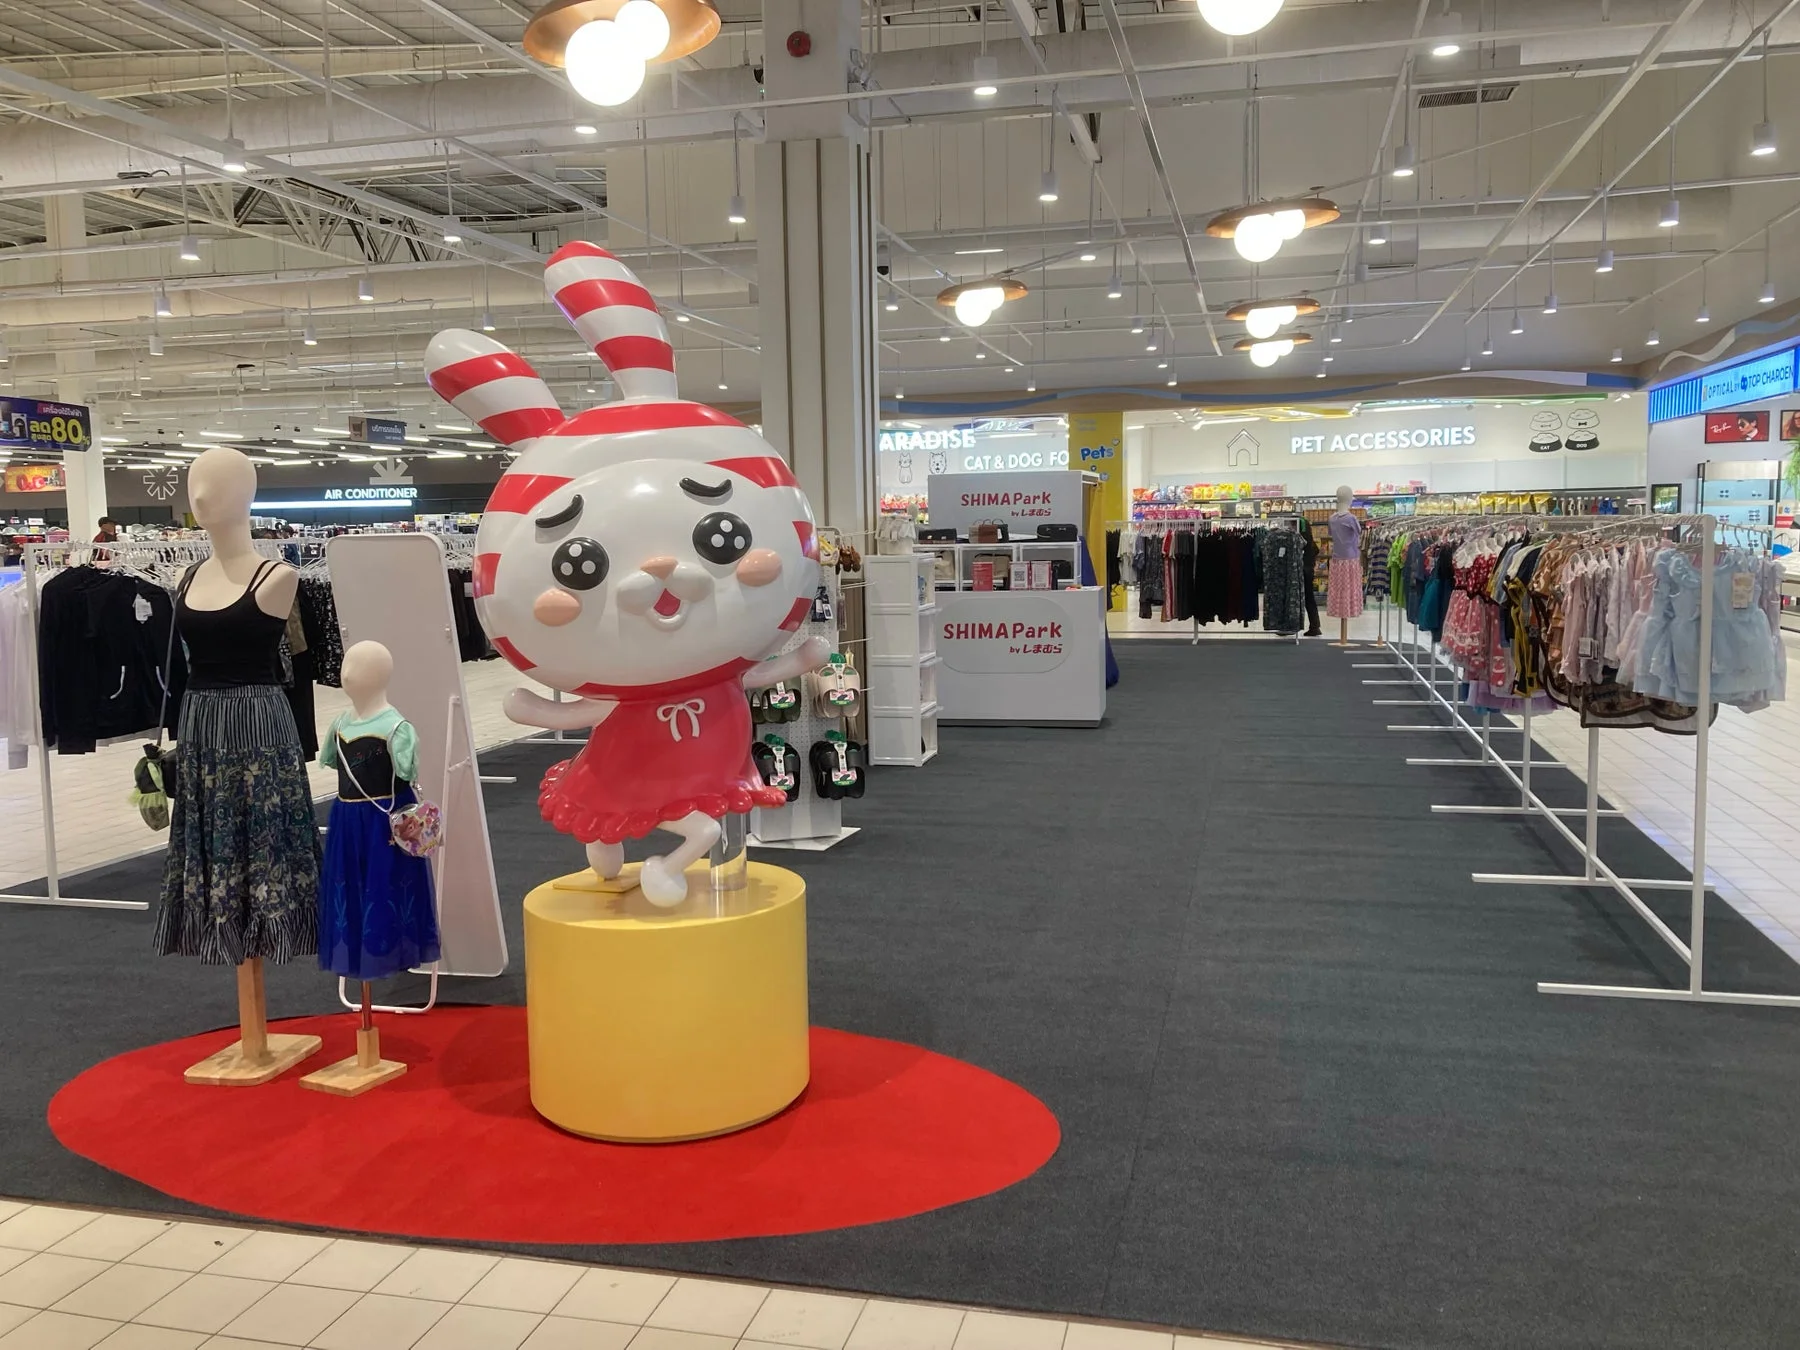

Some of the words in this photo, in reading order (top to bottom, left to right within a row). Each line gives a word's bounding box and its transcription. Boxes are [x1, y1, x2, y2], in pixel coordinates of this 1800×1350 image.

[1748, 374, 1761, 388] TOP
[30, 420, 51, 433] ลด
[1291, 434, 1324, 455] PET
[1330, 426, 1476, 453] ACCESSORIES
[1080, 445, 1114, 461] Pets
[964, 455, 991, 471] CAT
[994, 455, 1008, 469] &
[1009, 452, 1042, 468] DOG
[324, 488, 342, 500] AIR
[345, 487, 418, 500] CONDITIONER
[1021, 508, 1052, 517] しまむら
[1009, 646, 1020, 655] by
[1022, 643, 1063, 654] しまむら
